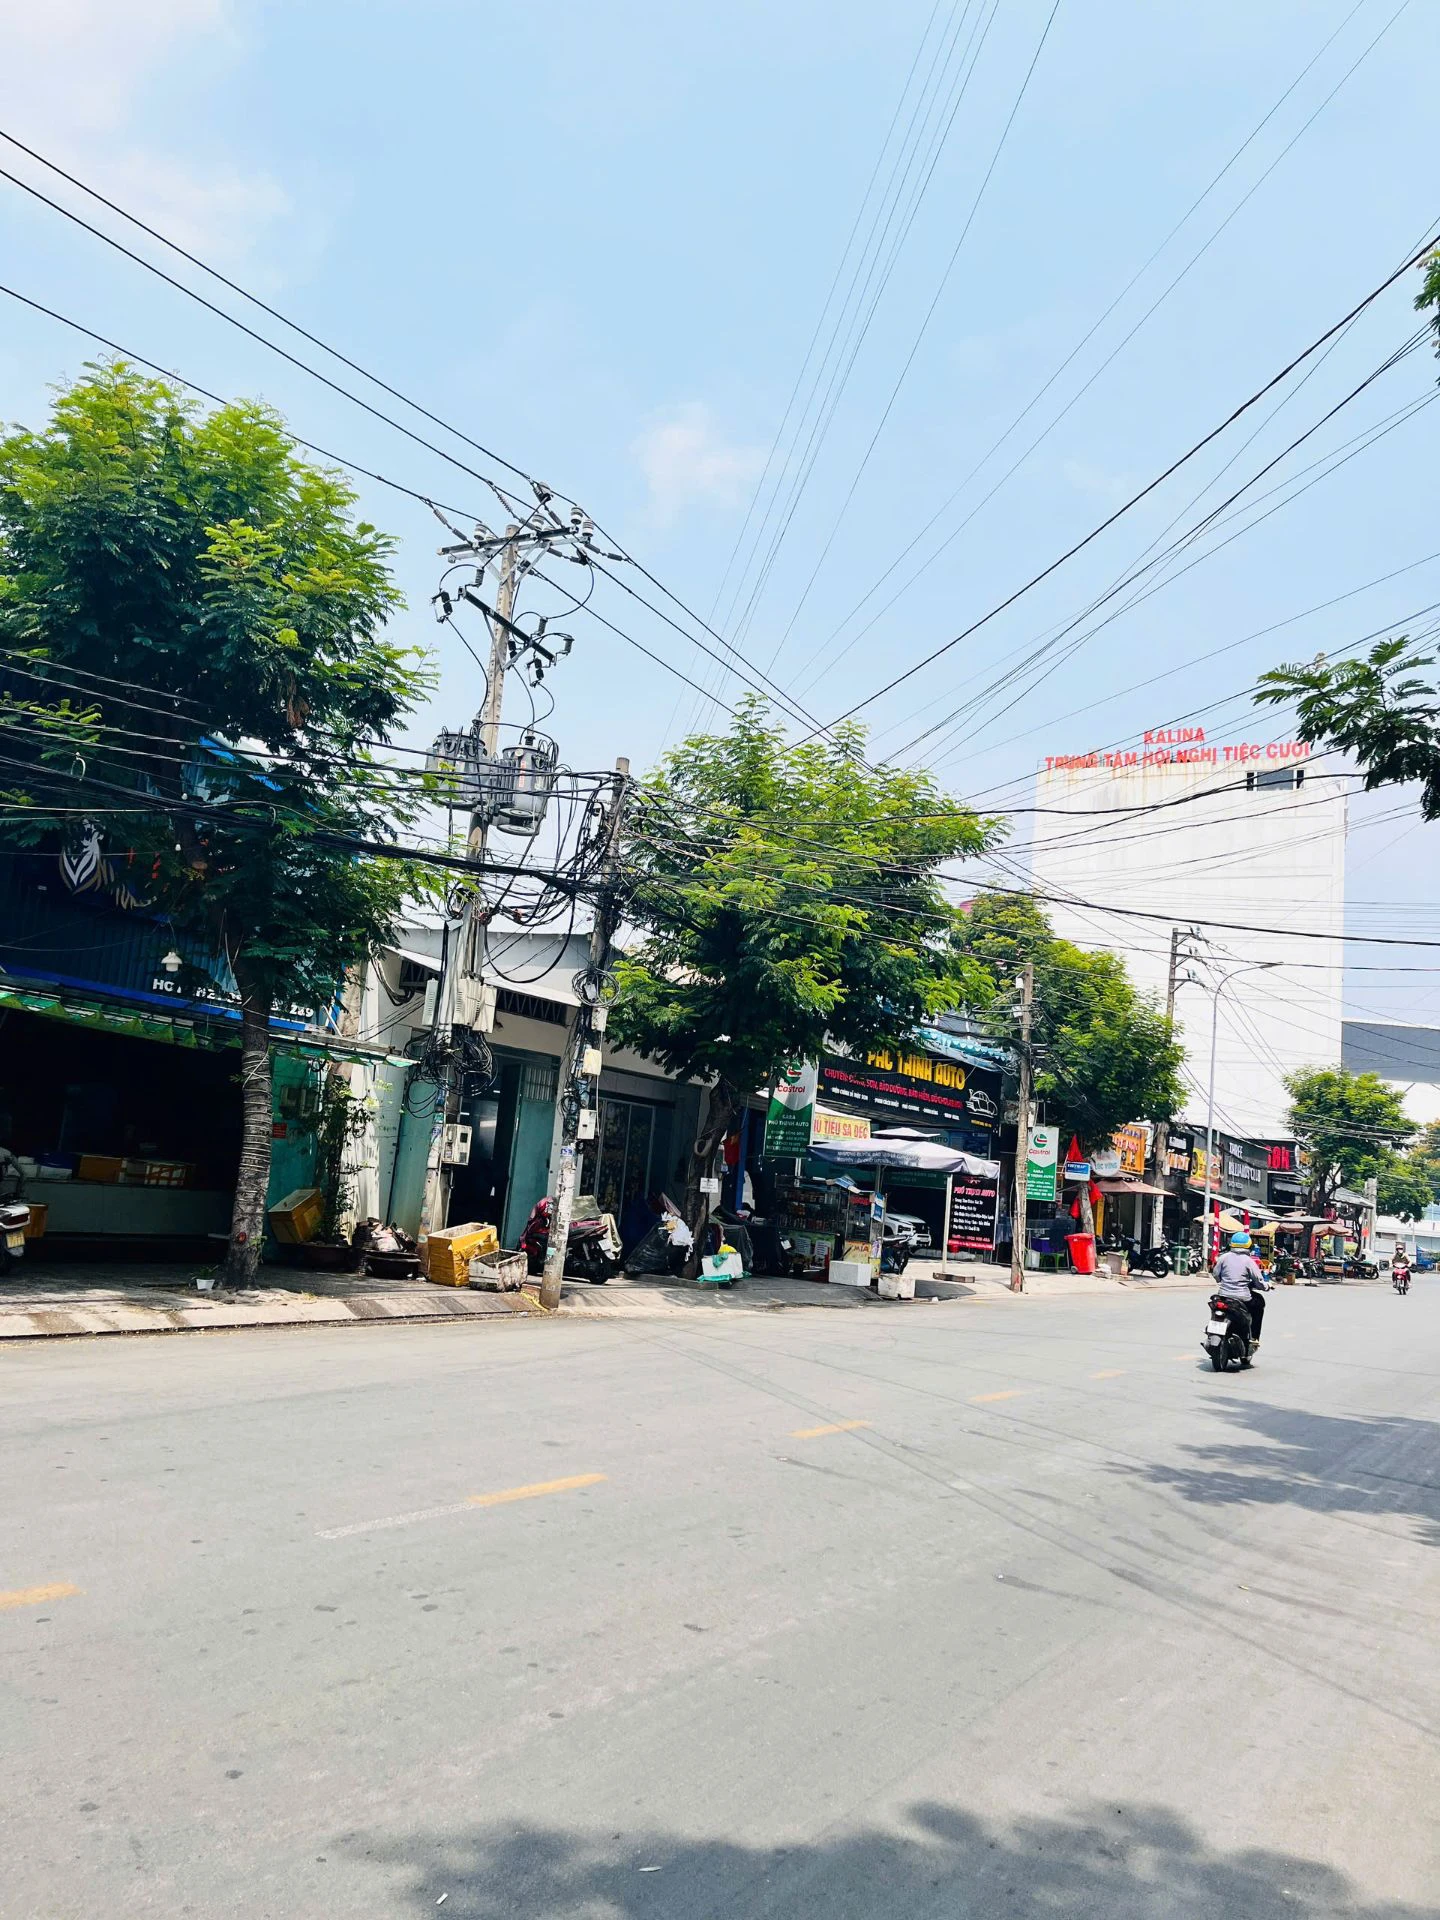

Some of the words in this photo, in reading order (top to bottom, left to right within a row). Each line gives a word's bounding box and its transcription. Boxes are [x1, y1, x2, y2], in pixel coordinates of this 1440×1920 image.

[1144, 727, 1205, 744] KALINA
[1045, 754, 1098, 769] TRUNG
[1104, 750, 1138, 768] TÂM
[1142, 747, 1171, 768] HỘI
[1177, 748, 1216, 765] NGHỊ
[1223, 742, 1261, 764] TIỆC
[934, 1062, 965, 1090] AUTO
[777, 1085, 805, 1093] Castrol
